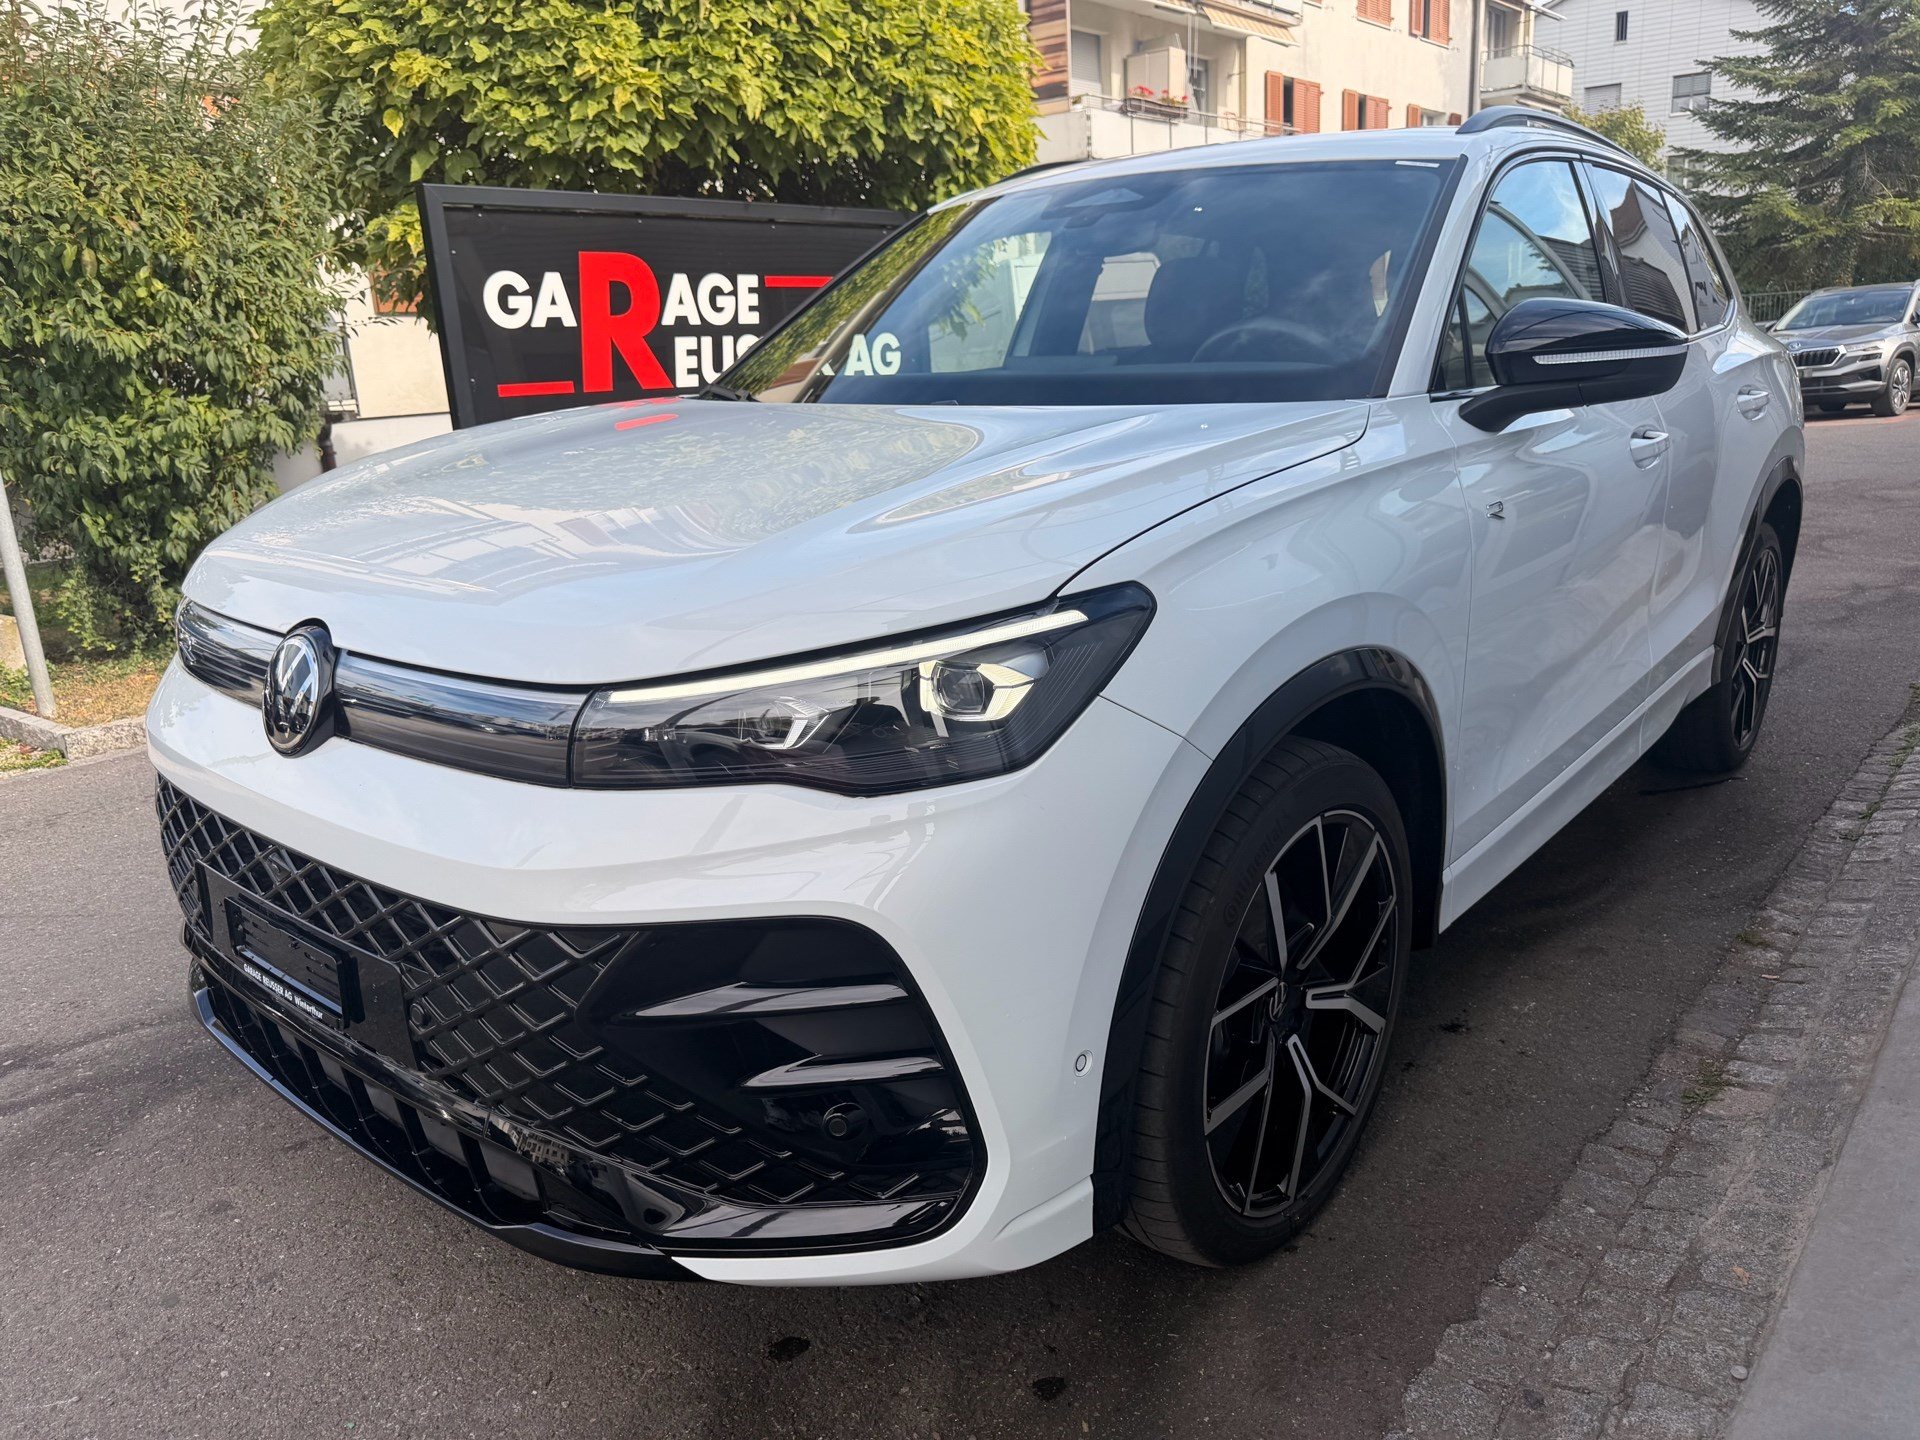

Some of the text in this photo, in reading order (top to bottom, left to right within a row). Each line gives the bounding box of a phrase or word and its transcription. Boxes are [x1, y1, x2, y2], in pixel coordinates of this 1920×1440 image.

[483, 251, 760, 393] GARAGE
[844, 332, 902, 376] AG
[243, 963, 323, 1019] GARAGE REUSSER AG Winterthur
